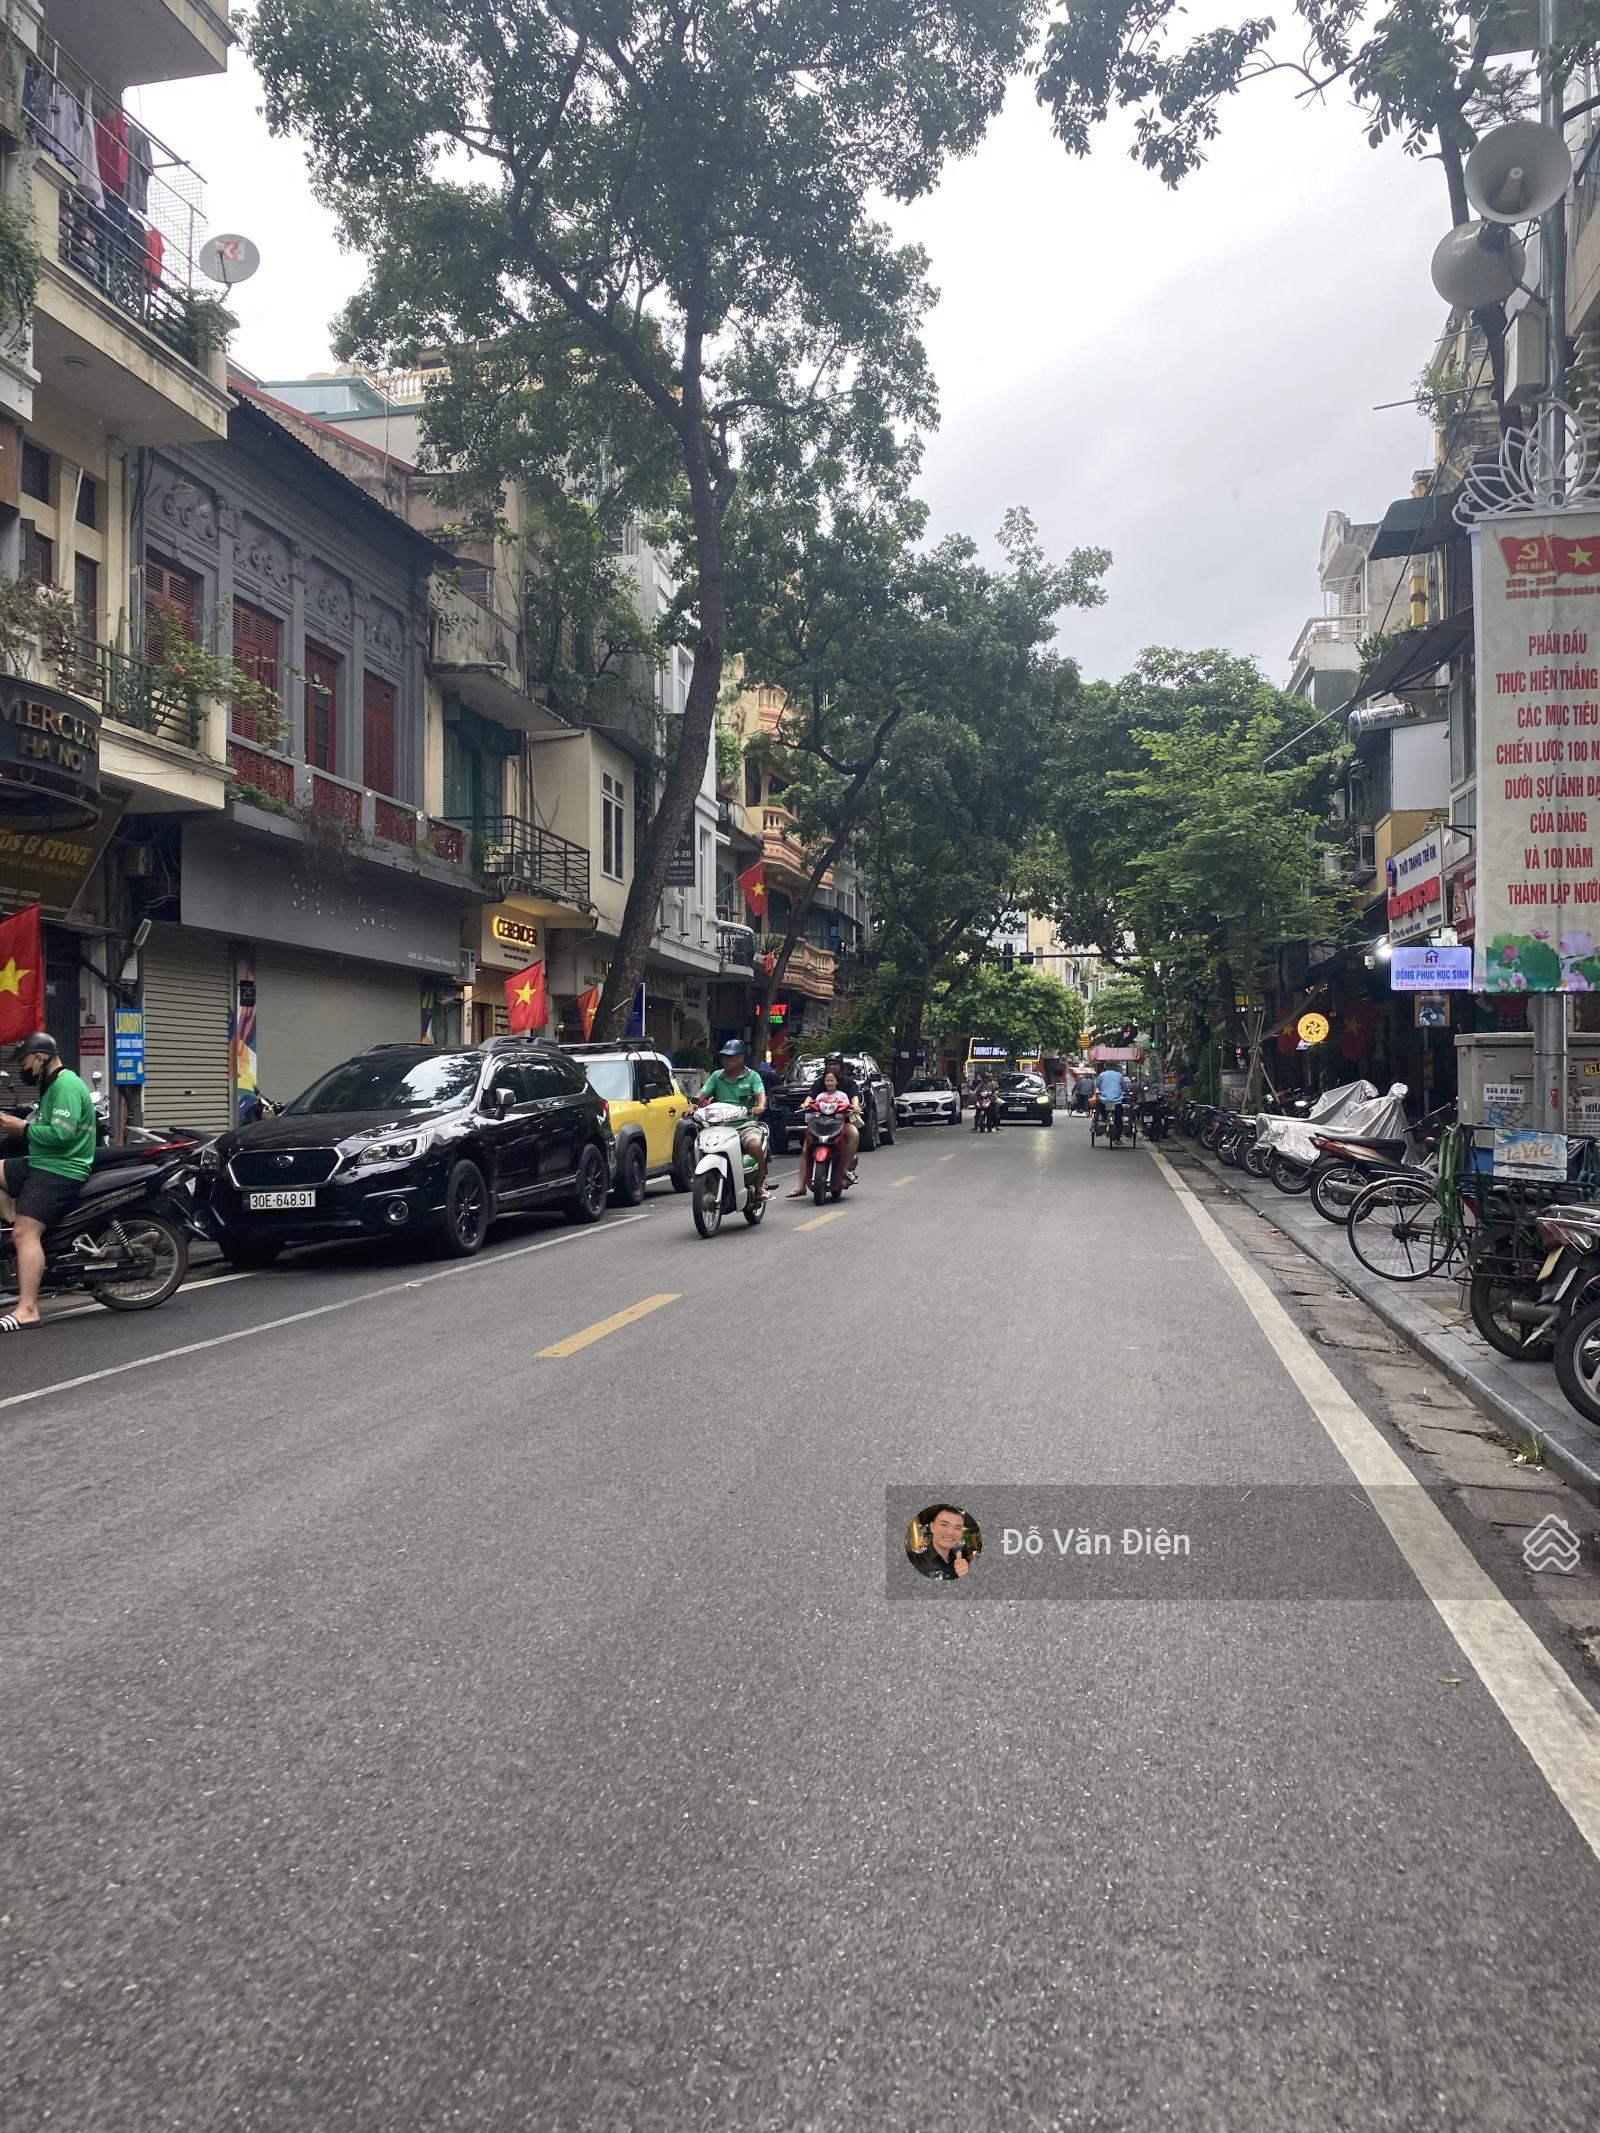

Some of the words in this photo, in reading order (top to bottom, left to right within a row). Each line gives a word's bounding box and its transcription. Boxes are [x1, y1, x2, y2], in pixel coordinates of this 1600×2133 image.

[1529, 626, 1560, 656] PHẤN
[1563, 626, 1587, 655] ĐẤU
[1496, 670, 1526, 698] THỰC
[1530, 665, 1557, 695] HIỆN
[1560, 661, 1598, 690] THẮNG
[1518, 702, 1541, 728] CÁC
[1546, 704, 1569, 731] MỤC
[1573, 700, 1598, 726] TIÊU
[1497, 736, 1532, 765] CHIẾN
[1536, 739, 1563, 766] LƯỢC
[1568, 741, 1588, 761] 100
[1505, 774, 1533, 799] DƯỚI
[1537, 774, 1555, 802] SỰ
[1556, 772, 1583, 797] LÃNH
[1530, 806, 1554, 834] CỦA
[1557, 805, 1587, 832] ĐẢNG
[39, 838, 94, 867] STONE
[1525, 844, 1539, 870] VÀ
[1544, 848, 1563, 869] 100
[1566, 843, 1593, 868] NĂM
[1508, 880, 1547, 905] THÀNH
[1551, 878, 1571, 909] LẬP
[1453, 970, 1469, 980] SINH
[115, 1013, 142, 1034] LAUNDRY
[973, 1046, 992, 1056] TOURIST
[53, 1107, 70, 1118] Grab
[251, 1193, 312, 1208] 30E-648.91
